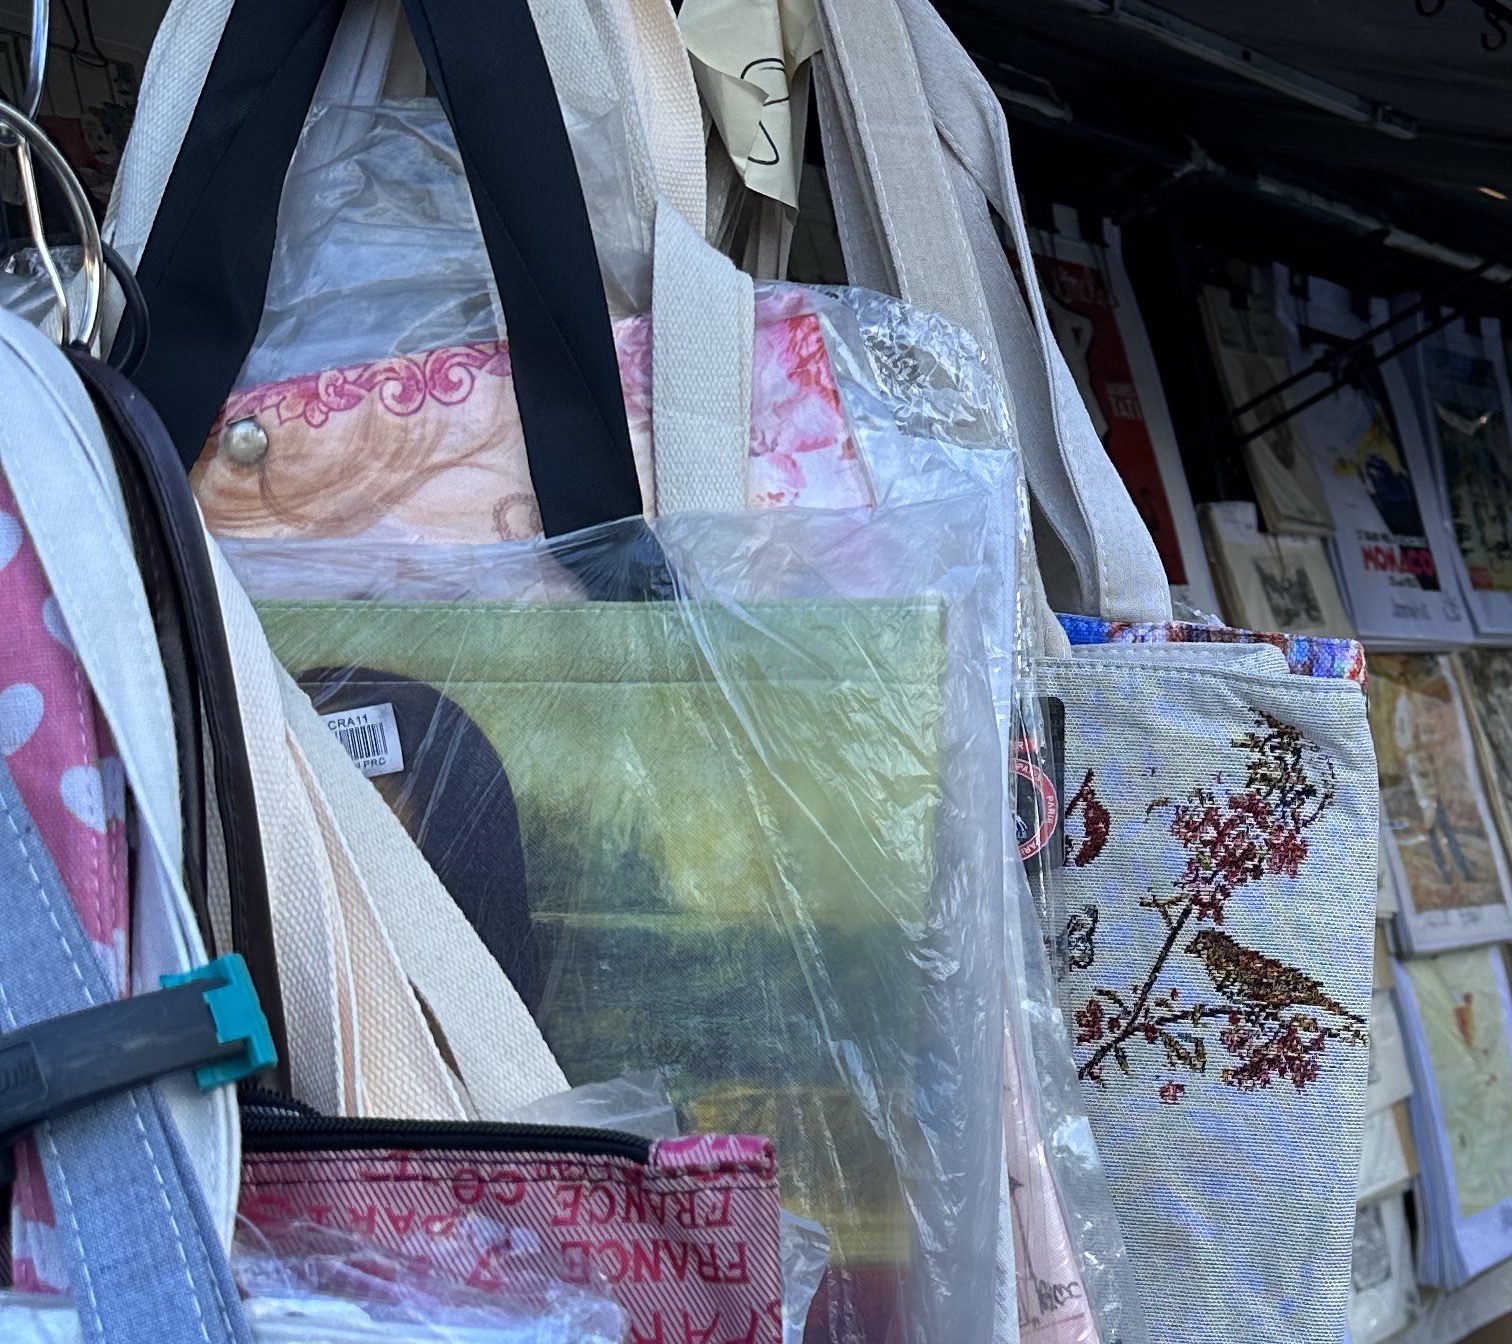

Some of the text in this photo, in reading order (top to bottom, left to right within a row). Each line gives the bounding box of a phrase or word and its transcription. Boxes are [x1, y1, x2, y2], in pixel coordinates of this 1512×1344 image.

[327, 713, 369, 731] CRA11
[363, 757, 388, 769] PRC
[550, 1181, 733, 1230] FRANCE
[560, 1239, 751, 1286] FRANCE
